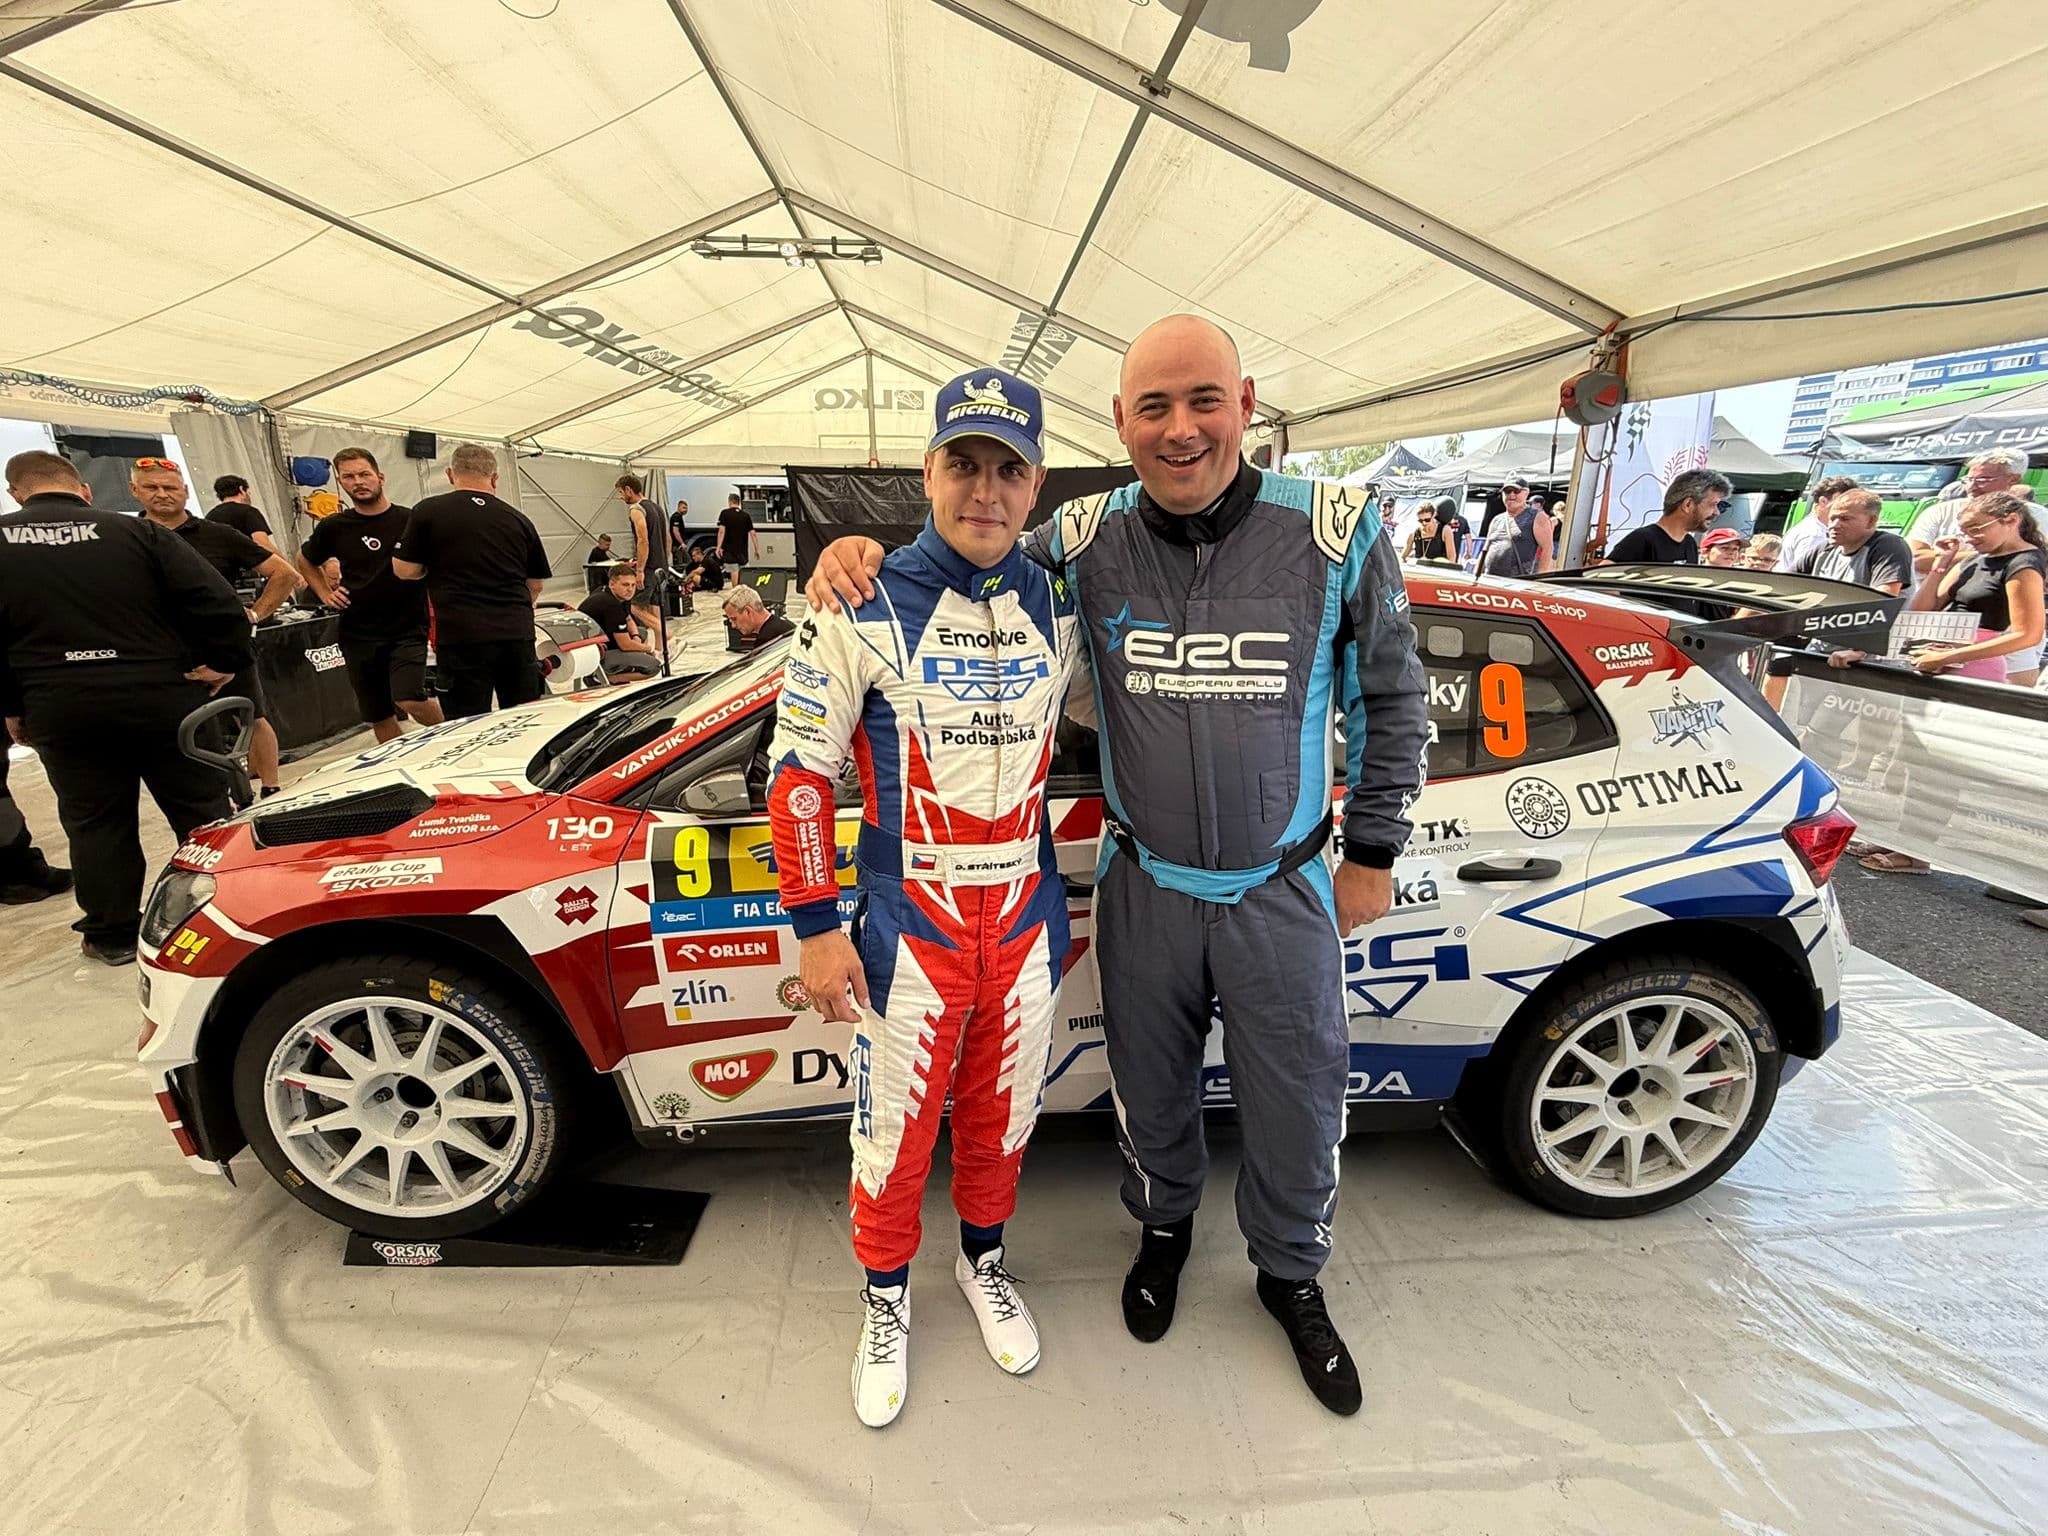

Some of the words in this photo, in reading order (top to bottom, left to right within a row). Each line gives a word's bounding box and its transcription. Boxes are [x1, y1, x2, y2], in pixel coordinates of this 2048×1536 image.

[946, 405, 1029, 427] MICHELIN
[1888, 429, 1993, 450] TRANSIT
[1532, 600, 1588, 621] E-shop
[64, 648, 119, 661] sparco
[1124, 629, 1291, 669] ERC
[1605, 657, 1654, 671] RALLYSPORT
[1158, 677, 1233, 689] EUROPEAN
[1236, 679, 1283, 689] RALLY
[1157, 690, 1284, 701] CHAMPIONSHIP
[1479, 662, 1528, 759] 9
[408, 823, 478, 839] AUTOMOTOR
[418, 816, 446, 828] Lumír
[546, 815, 614, 841] 130
[1420, 817, 1464, 842] TK
[1418, 840, 1472, 857] KONTROLY
[332, 864, 387, 879] eRally
[389, 862, 427, 873] Cup
[673, 825, 713, 899] 9
[732, 903, 761, 919] FIA
[764, 900, 791, 917] ER
[707, 941, 769, 959] ORLEN
[703, 1057, 751, 1084] MOL
[382, 1244, 438, 1258] ORSAK
